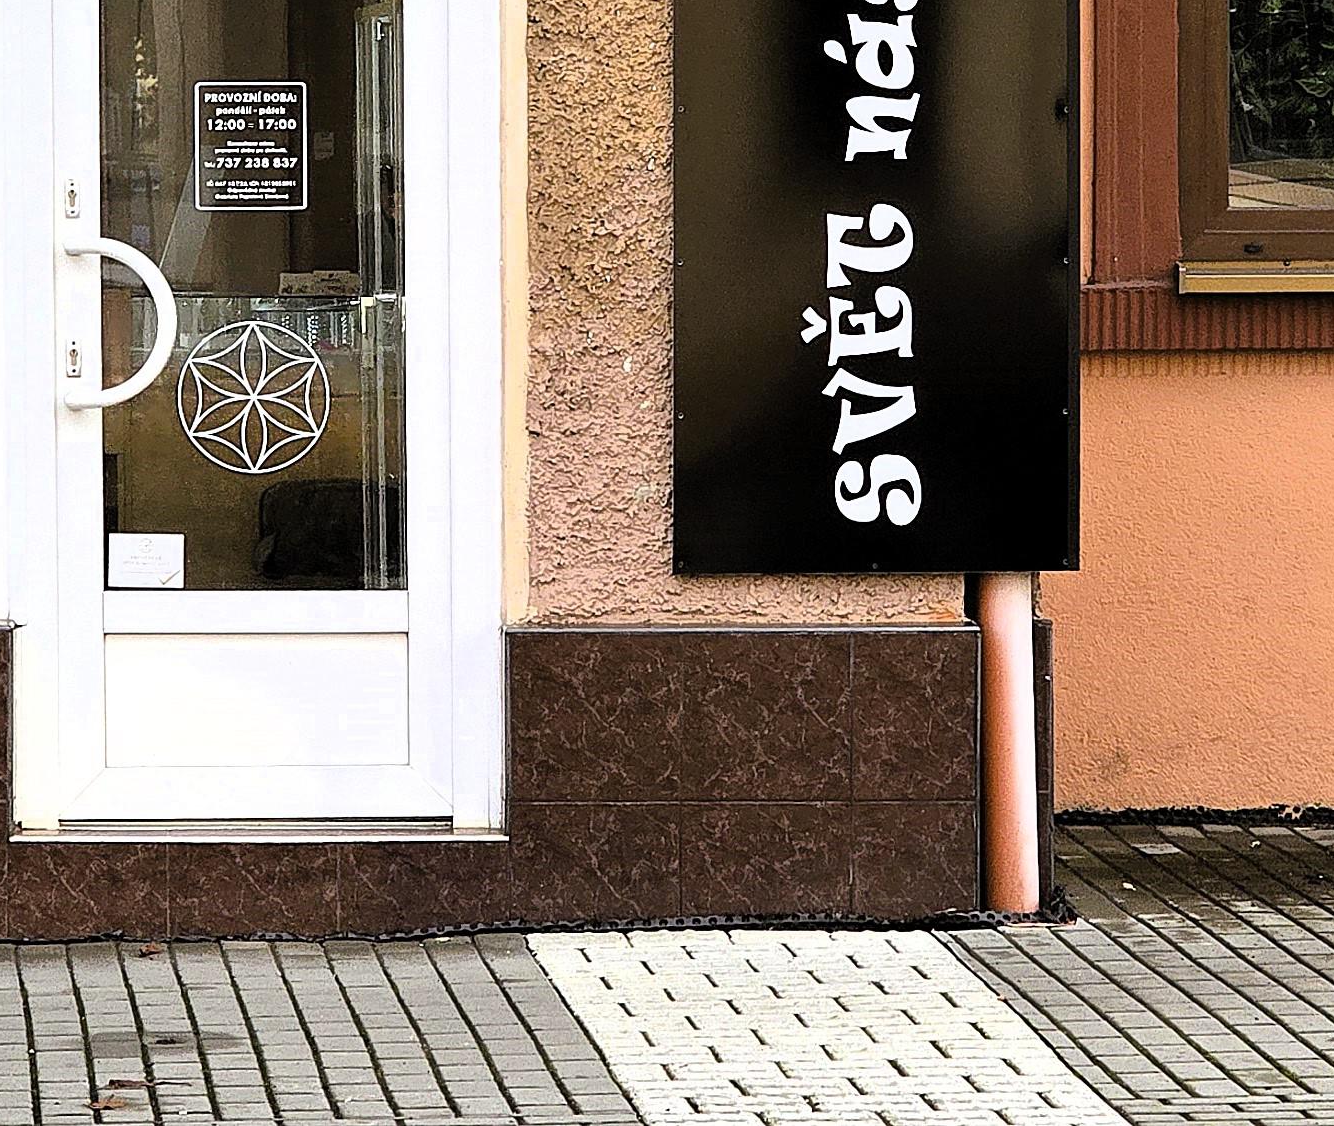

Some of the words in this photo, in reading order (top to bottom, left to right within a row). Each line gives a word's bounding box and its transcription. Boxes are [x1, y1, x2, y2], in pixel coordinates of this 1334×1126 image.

[204, 91, 262, 102] PROVOZNÍ
[207, 119, 245, 130] 12:00
[259, 119, 297, 129] 17:00
[216, 158, 241, 168] 737
[245, 158, 269, 168] 238
[273, 158, 298, 168] 837
[800, 203, 921, 526] SVĚT
